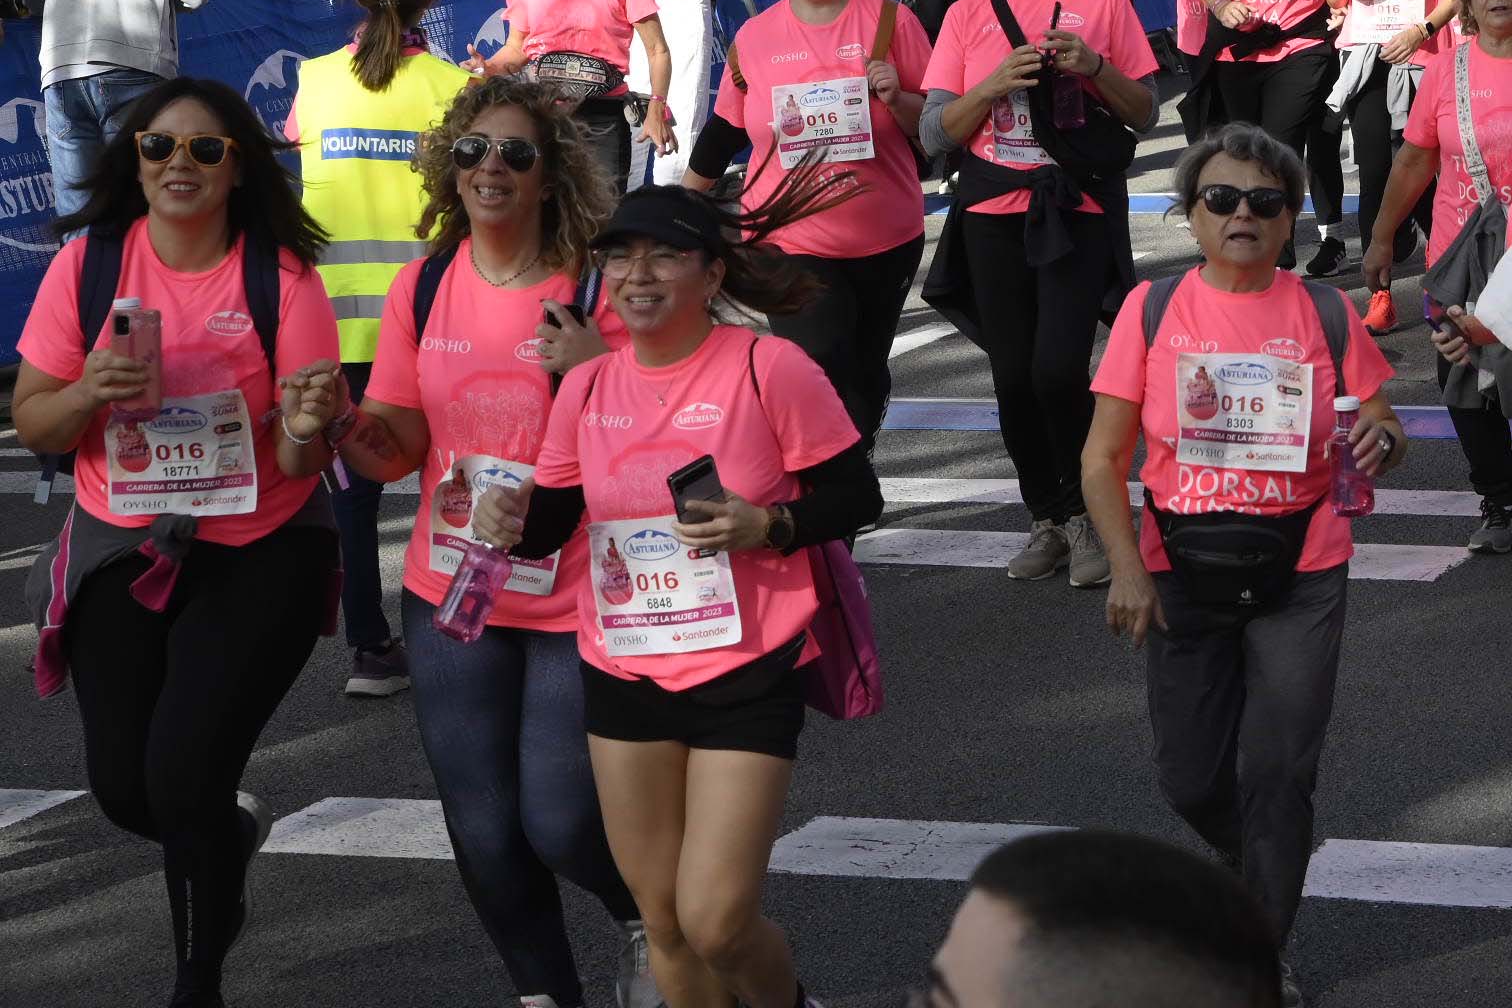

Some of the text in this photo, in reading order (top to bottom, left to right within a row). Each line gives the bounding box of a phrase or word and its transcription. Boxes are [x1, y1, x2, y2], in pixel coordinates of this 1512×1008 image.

[771, 51, 808, 64] OYSHO
[802, 94, 837, 105] ASTURIANA
[806, 111, 838, 127] 016
[814, 127, 834, 137] 7280
[1023, 129, 1034, 137] 72
[322, 136, 416, 153] VOLUNTARIS
[0, 150, 44, 171] ENTRAL
[422, 336, 472, 354] OYSHO
[1220, 366, 1269, 380] ASTURIANA
[1221, 395, 1264, 413] 016
[584, 411, 633, 430] OYSHO
[675, 412, 722, 425] ASTURIANA
[1226, 417, 1254, 429] 8303
[1194, 430, 1226, 441] CARRERA
[1226, 433, 1237, 441] DE
[1237, 434, 1247, 442] LA
[155, 442, 204, 461] 016
[1190, 446, 1225, 459] OYSHO
[162, 465, 200, 477] 18771
[126, 483, 165, 492] CARRERA
[166, 482, 178, 490] DE
[180, 481, 191, 489] LA
[1178, 466, 1297, 503] DORSAL
[123, 499, 167, 509] OYSHO
[202, 495, 247, 506] Santander
[627, 540, 675, 555] ASTURIANA
[636, 571, 679, 592] 016
[646, 597, 673, 609] 6848
[612, 607, 722, 626] CARRERA DE LA MUJER 2023
[682, 625, 729, 641] Santander
[613, 634, 648, 647] OYSHO
